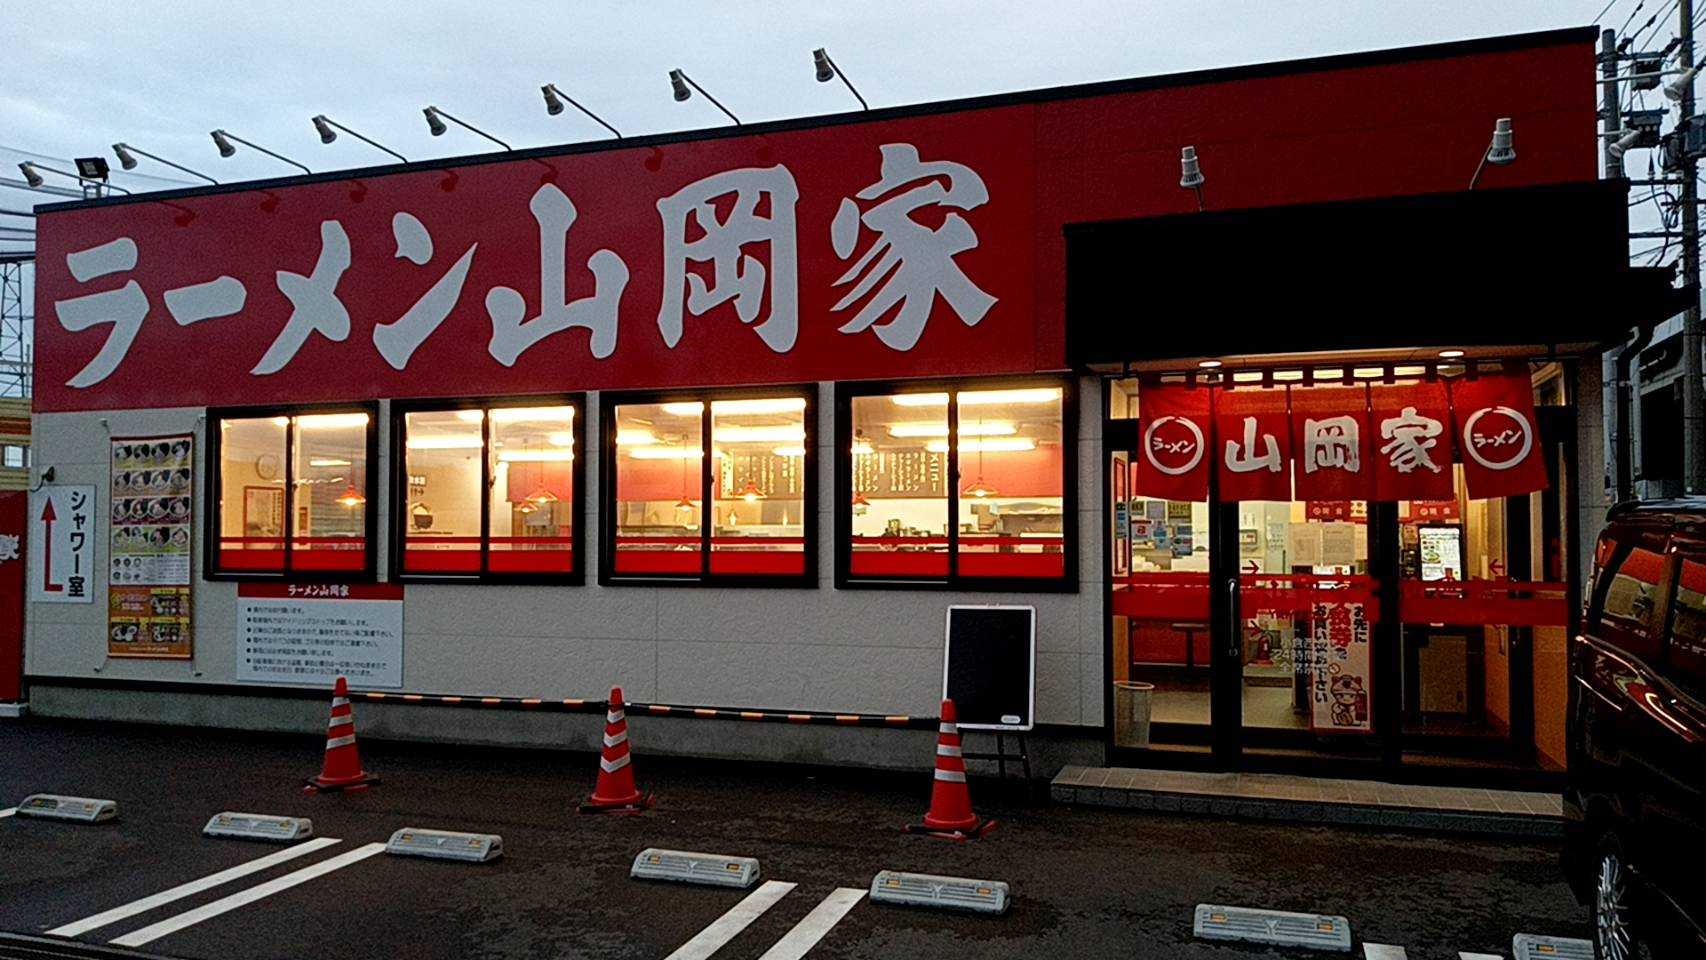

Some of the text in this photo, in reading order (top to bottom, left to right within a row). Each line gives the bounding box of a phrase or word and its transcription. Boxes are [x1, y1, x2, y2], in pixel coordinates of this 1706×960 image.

[54, 143, 998, 388] ラーメン山岡家
[1153, 437, 1196, 454] ラーメン
[1225, 406, 1444, 474] 山岡家
[1473, 429, 1522, 448] ラーメン
[68, 491, 87, 598] シャワー室
[288, 584, 350, 596] ラーメン山岡家
